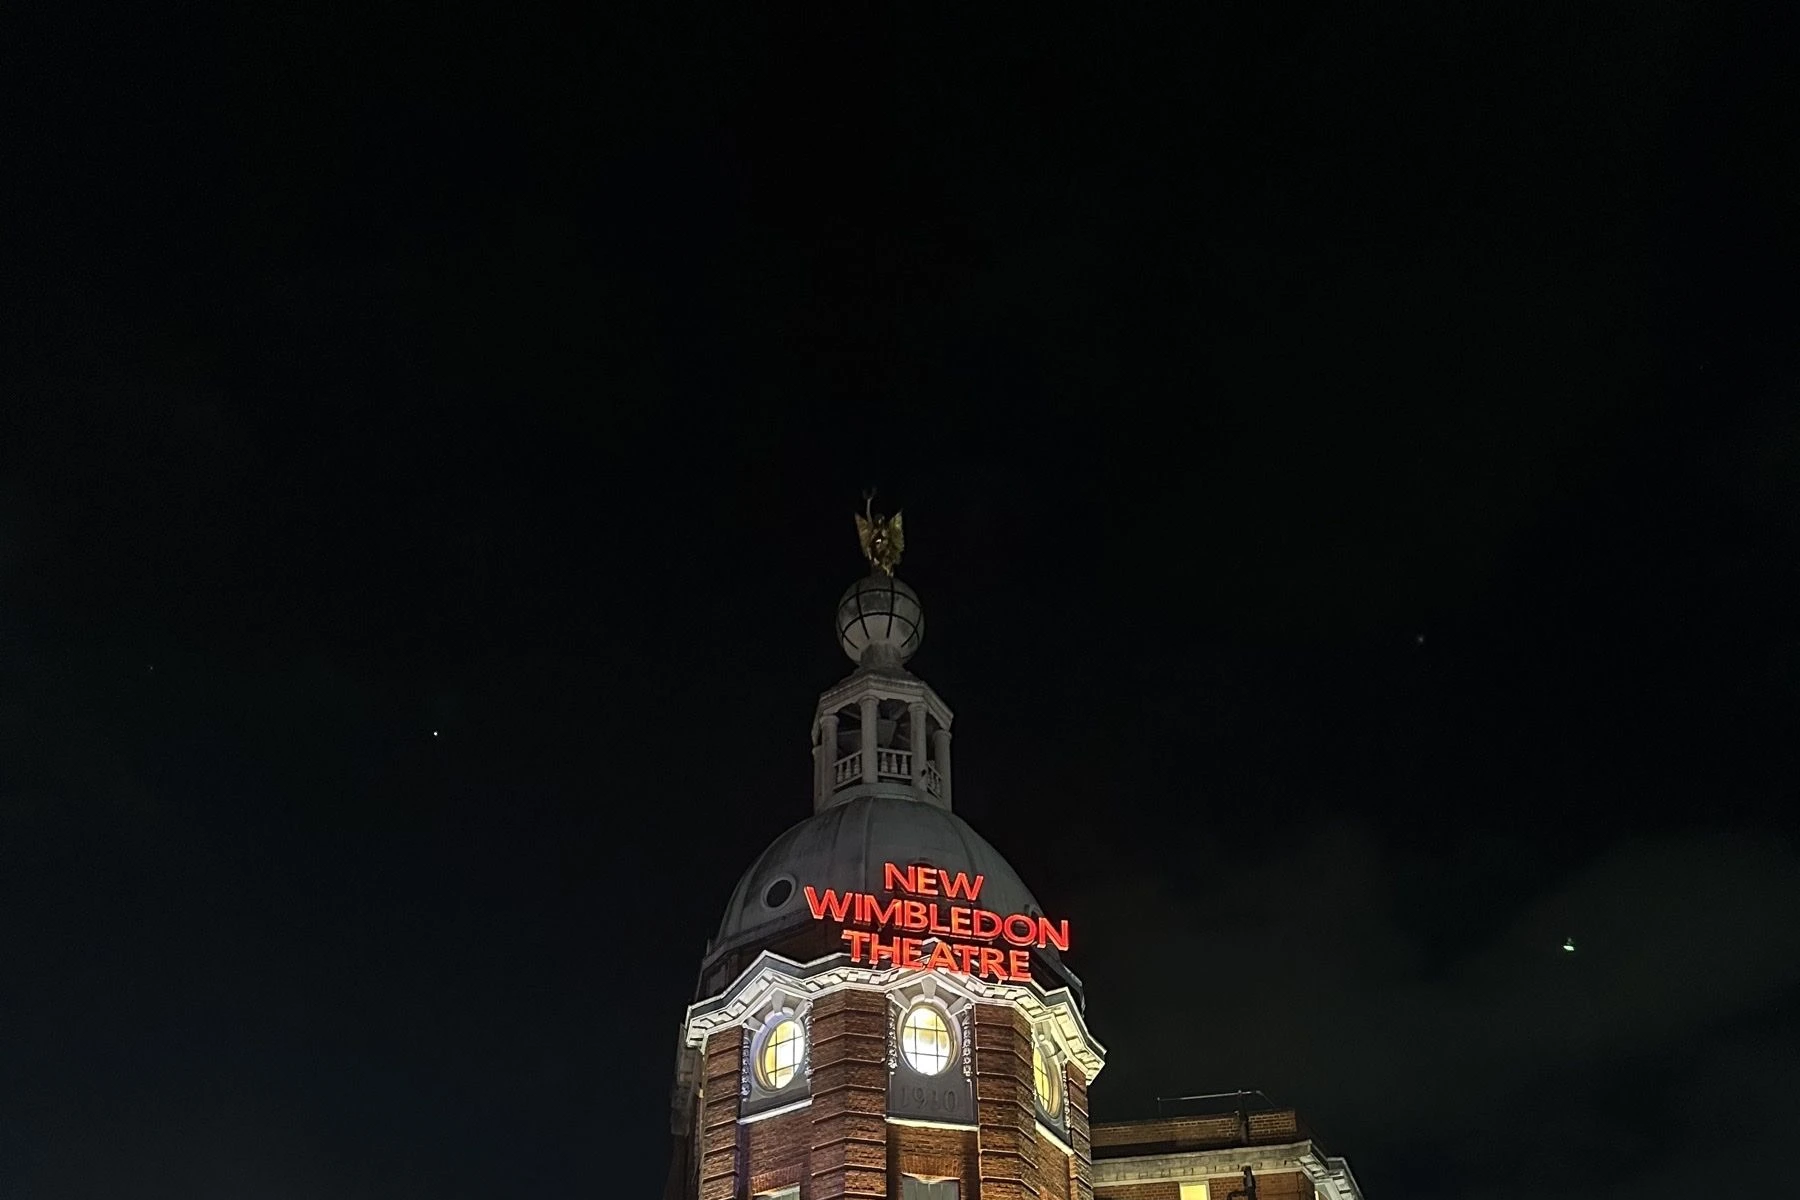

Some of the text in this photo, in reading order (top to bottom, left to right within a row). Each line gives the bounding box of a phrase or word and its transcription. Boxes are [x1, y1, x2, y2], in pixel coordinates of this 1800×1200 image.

[884, 862, 984, 901] NEW
[804, 886, 1070, 951] WIMBLEDON
[842, 929, 1033, 982] THEATRE
